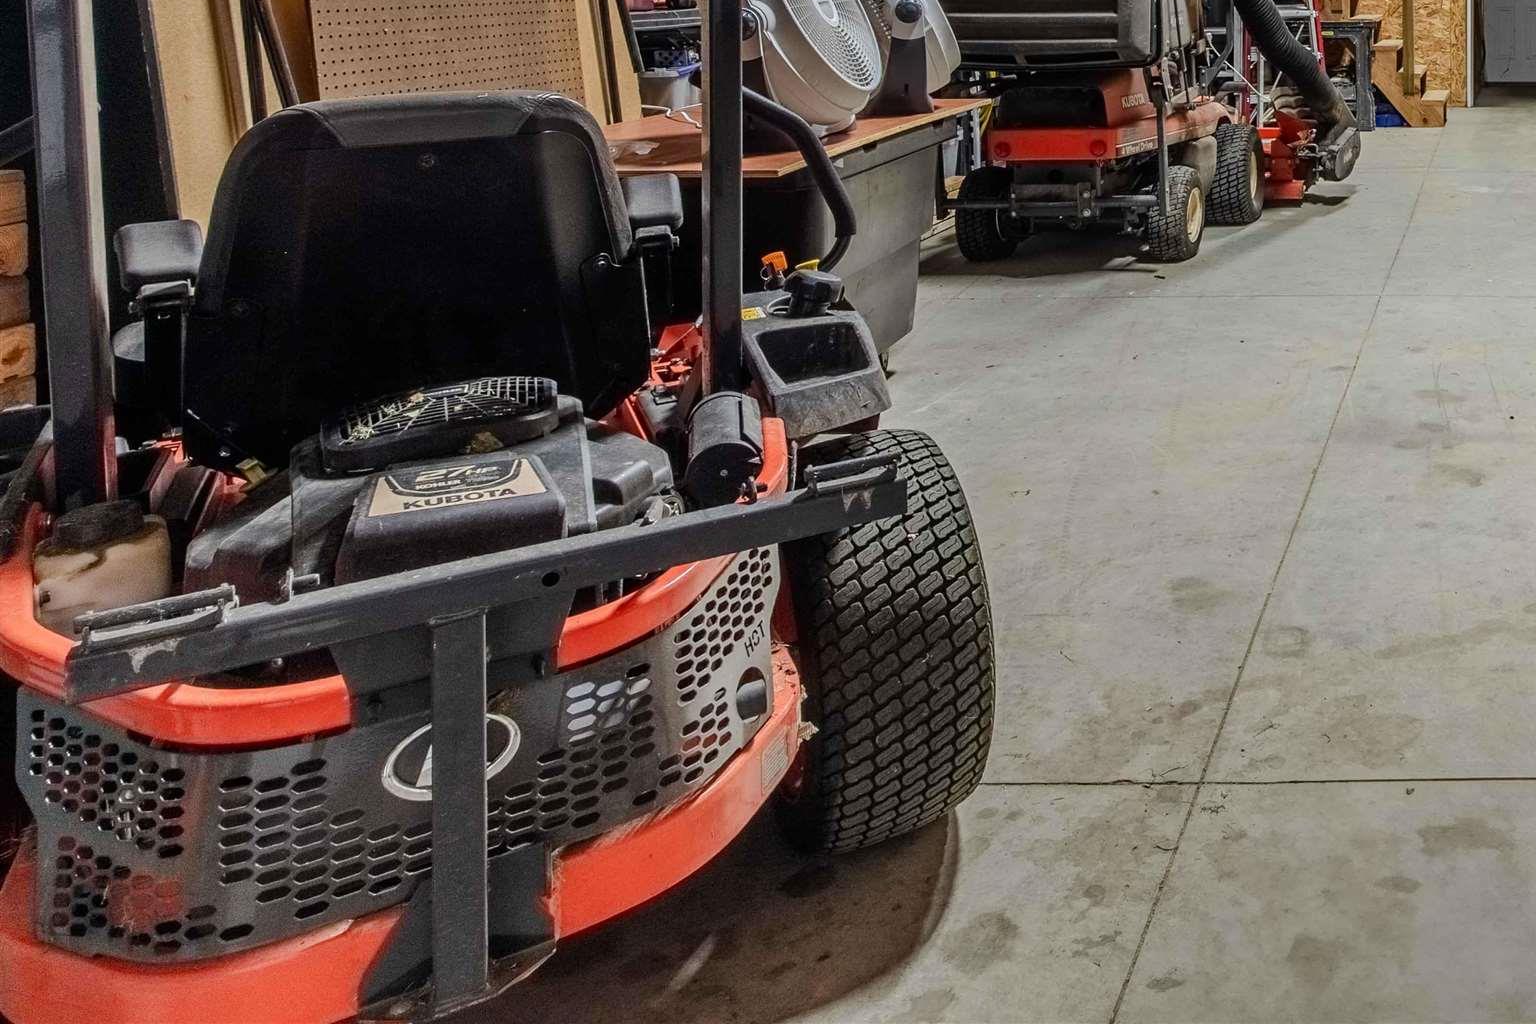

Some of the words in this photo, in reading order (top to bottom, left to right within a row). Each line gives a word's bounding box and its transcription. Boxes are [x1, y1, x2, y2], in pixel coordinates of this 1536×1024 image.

[1121, 93, 1146, 109] KUBOTA
[415, 479, 461, 491] KOHLER
[403, 488, 516, 510] KUBOTA
[744, 620, 766, 658] HOT
